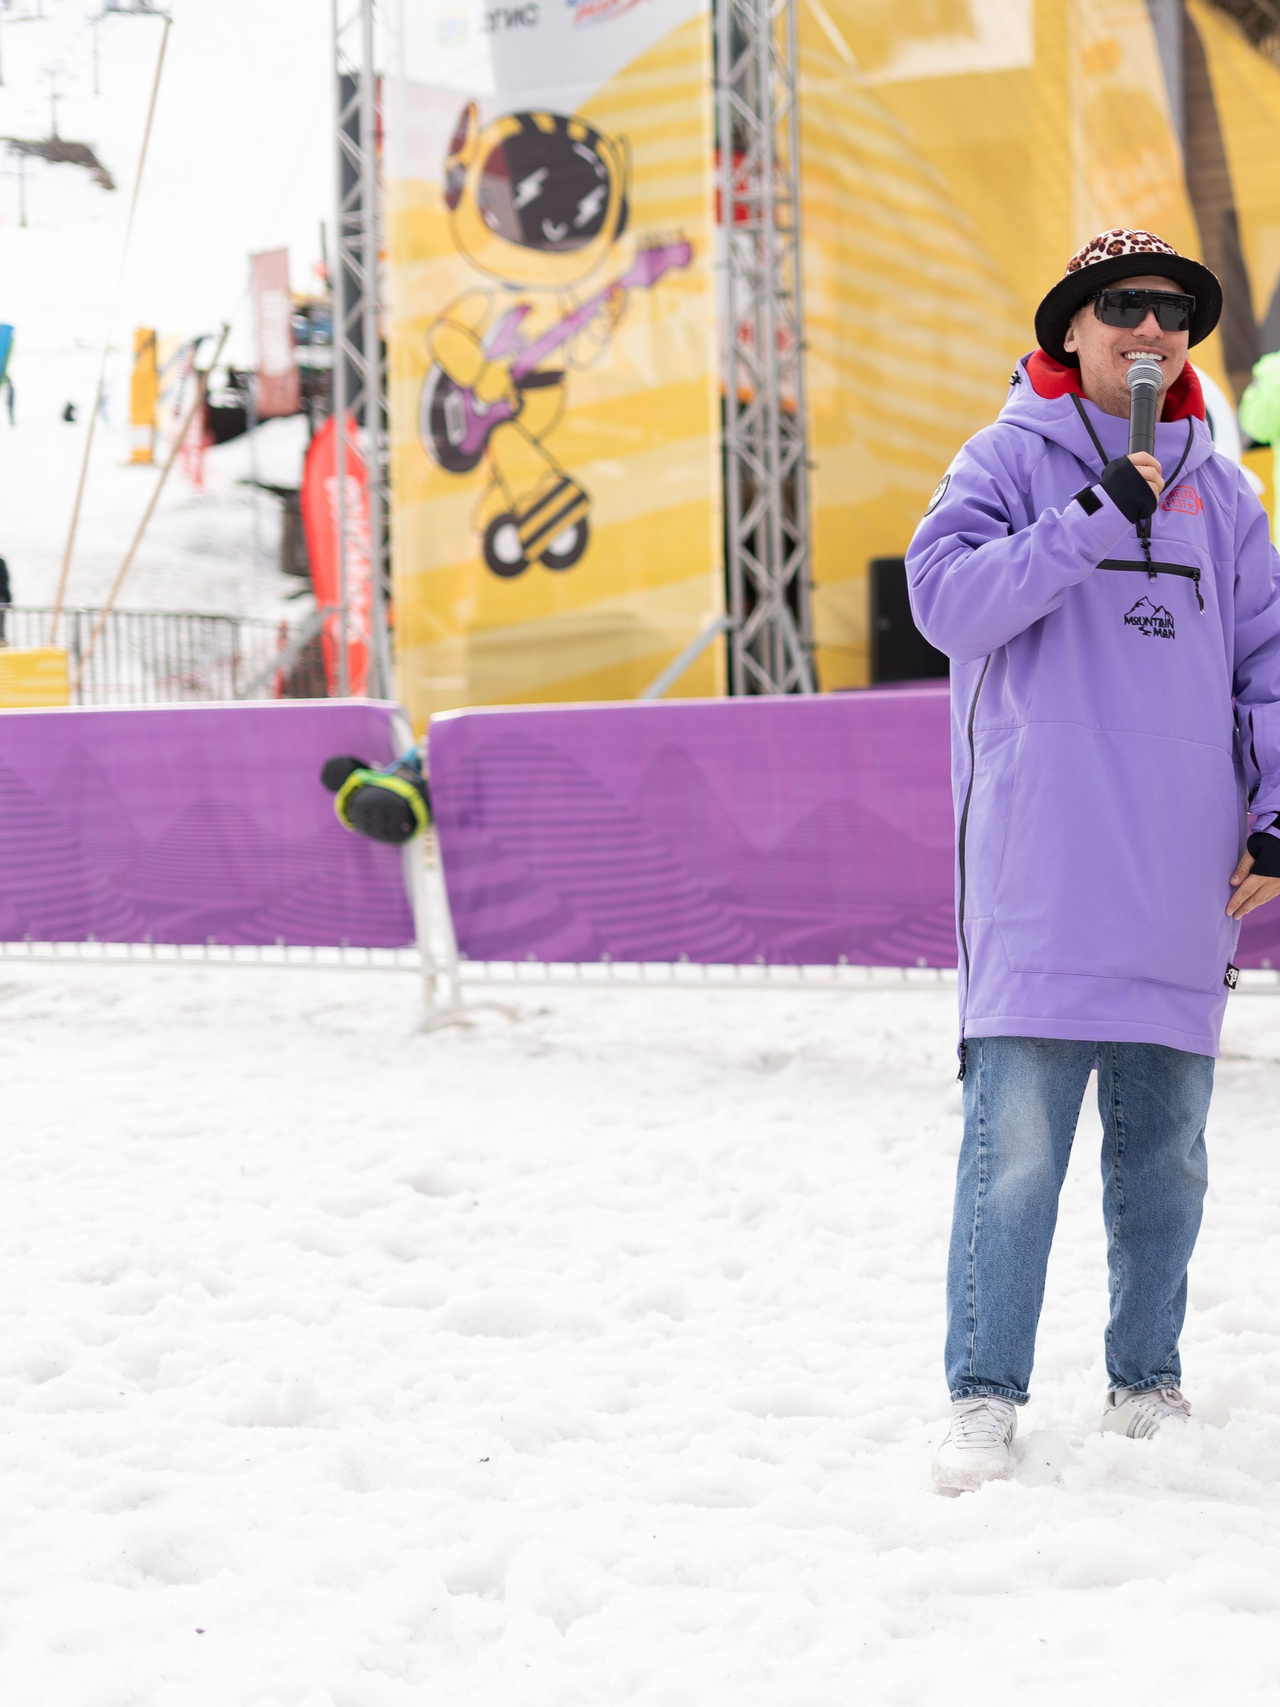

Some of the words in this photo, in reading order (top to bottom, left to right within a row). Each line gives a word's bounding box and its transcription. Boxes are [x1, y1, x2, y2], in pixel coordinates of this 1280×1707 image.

[1166, 498, 1187, 509] FEST
[1124, 615, 1175, 630] MOUNTAIN
[1153, 627, 1175, 640] MAN
